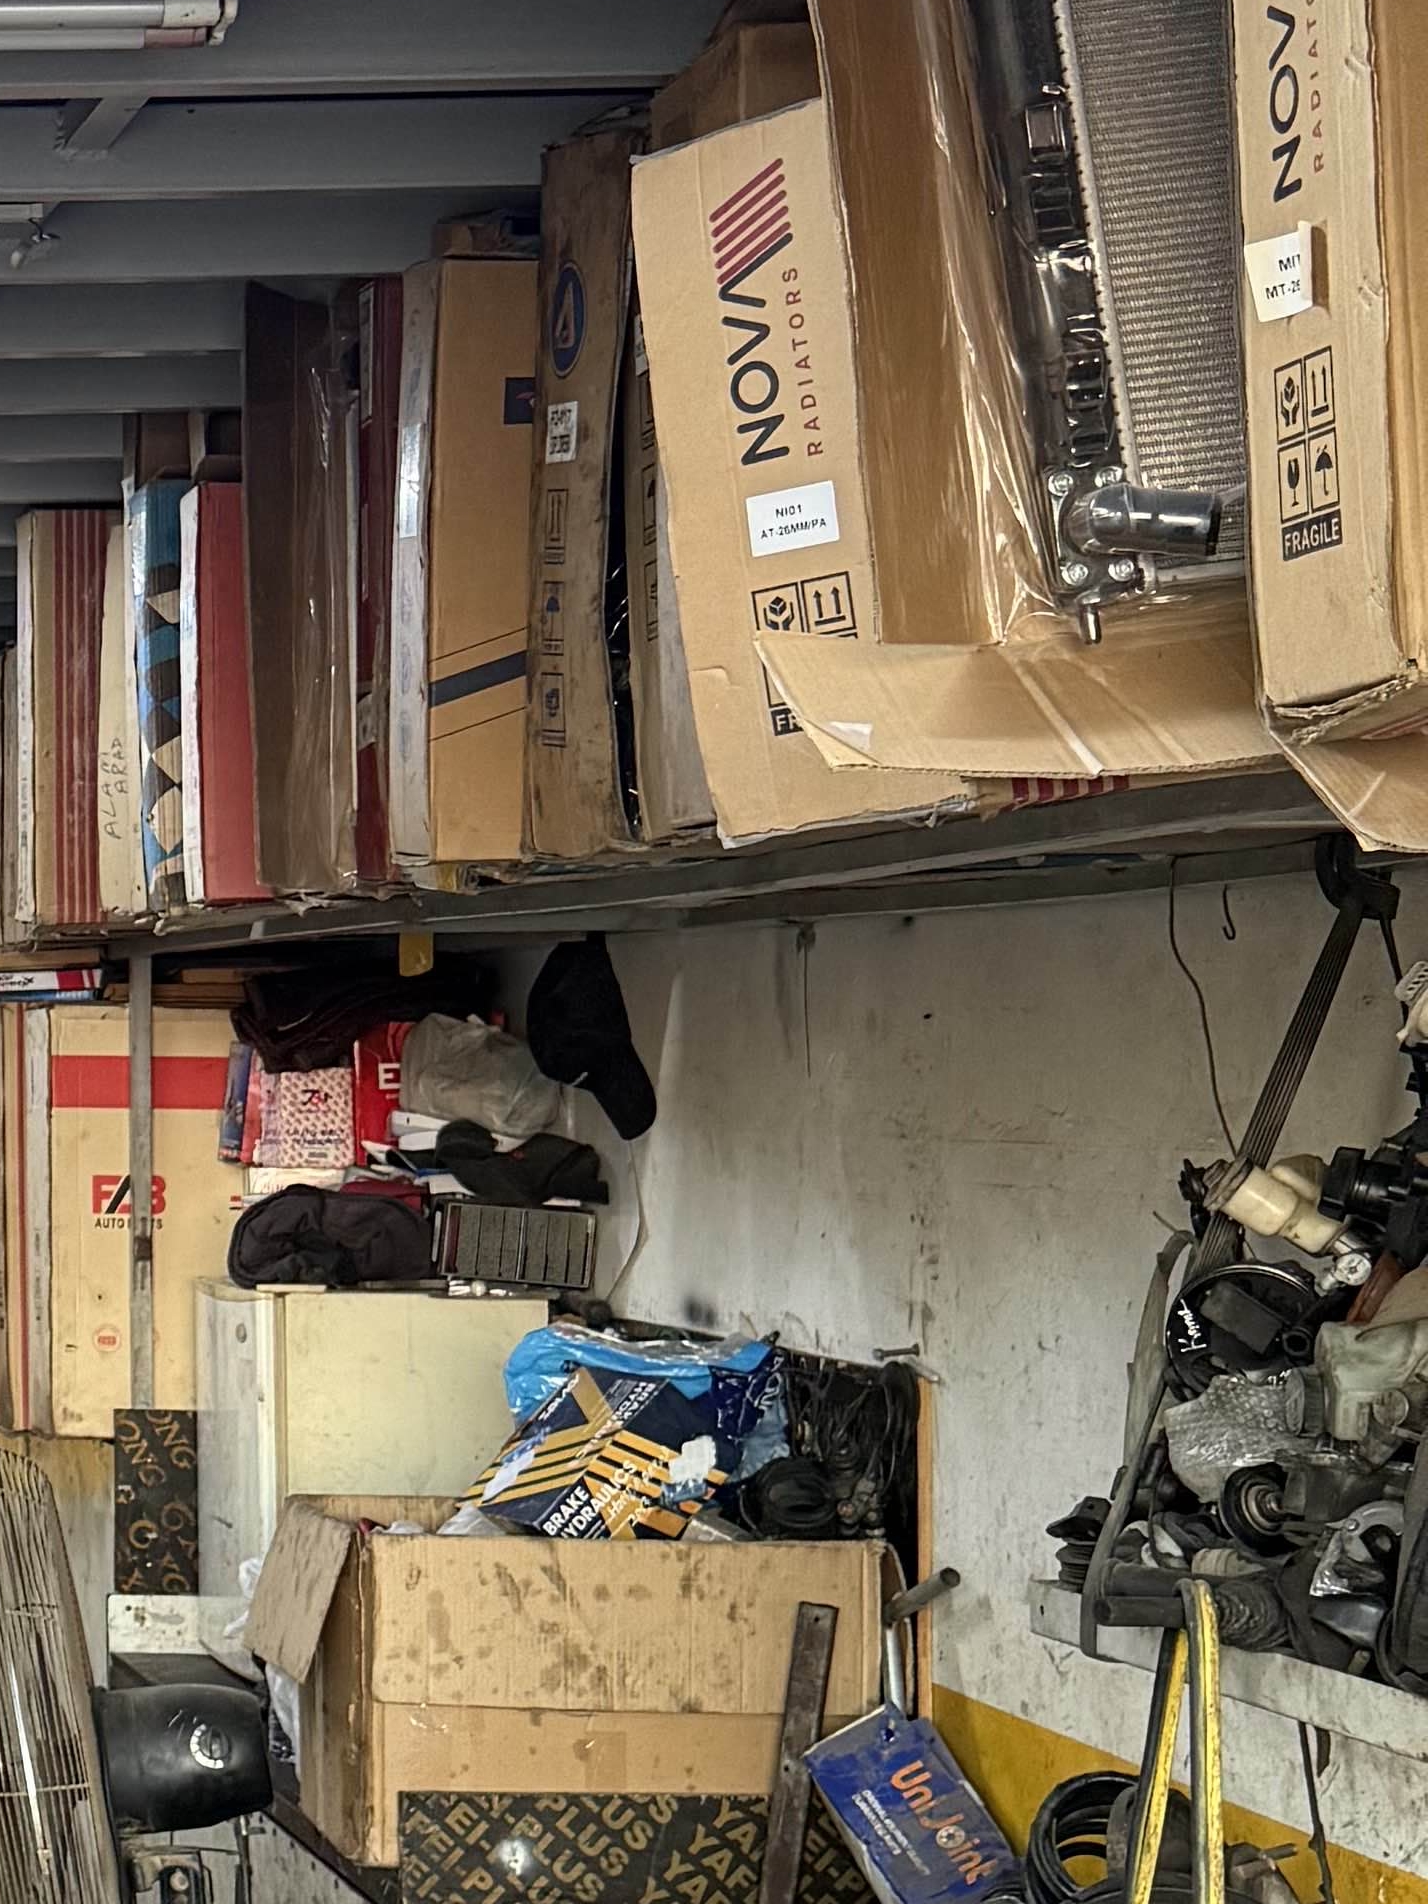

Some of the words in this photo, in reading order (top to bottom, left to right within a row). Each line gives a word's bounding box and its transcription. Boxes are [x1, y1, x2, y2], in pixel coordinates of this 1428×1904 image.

[780, 264, 826, 458] RADIATORS
[1284, 516, 1340, 557] FRAGILE
[94, 1217, 125, 1230] AUTO
[542, 1485, 590, 1537] BRAKE
